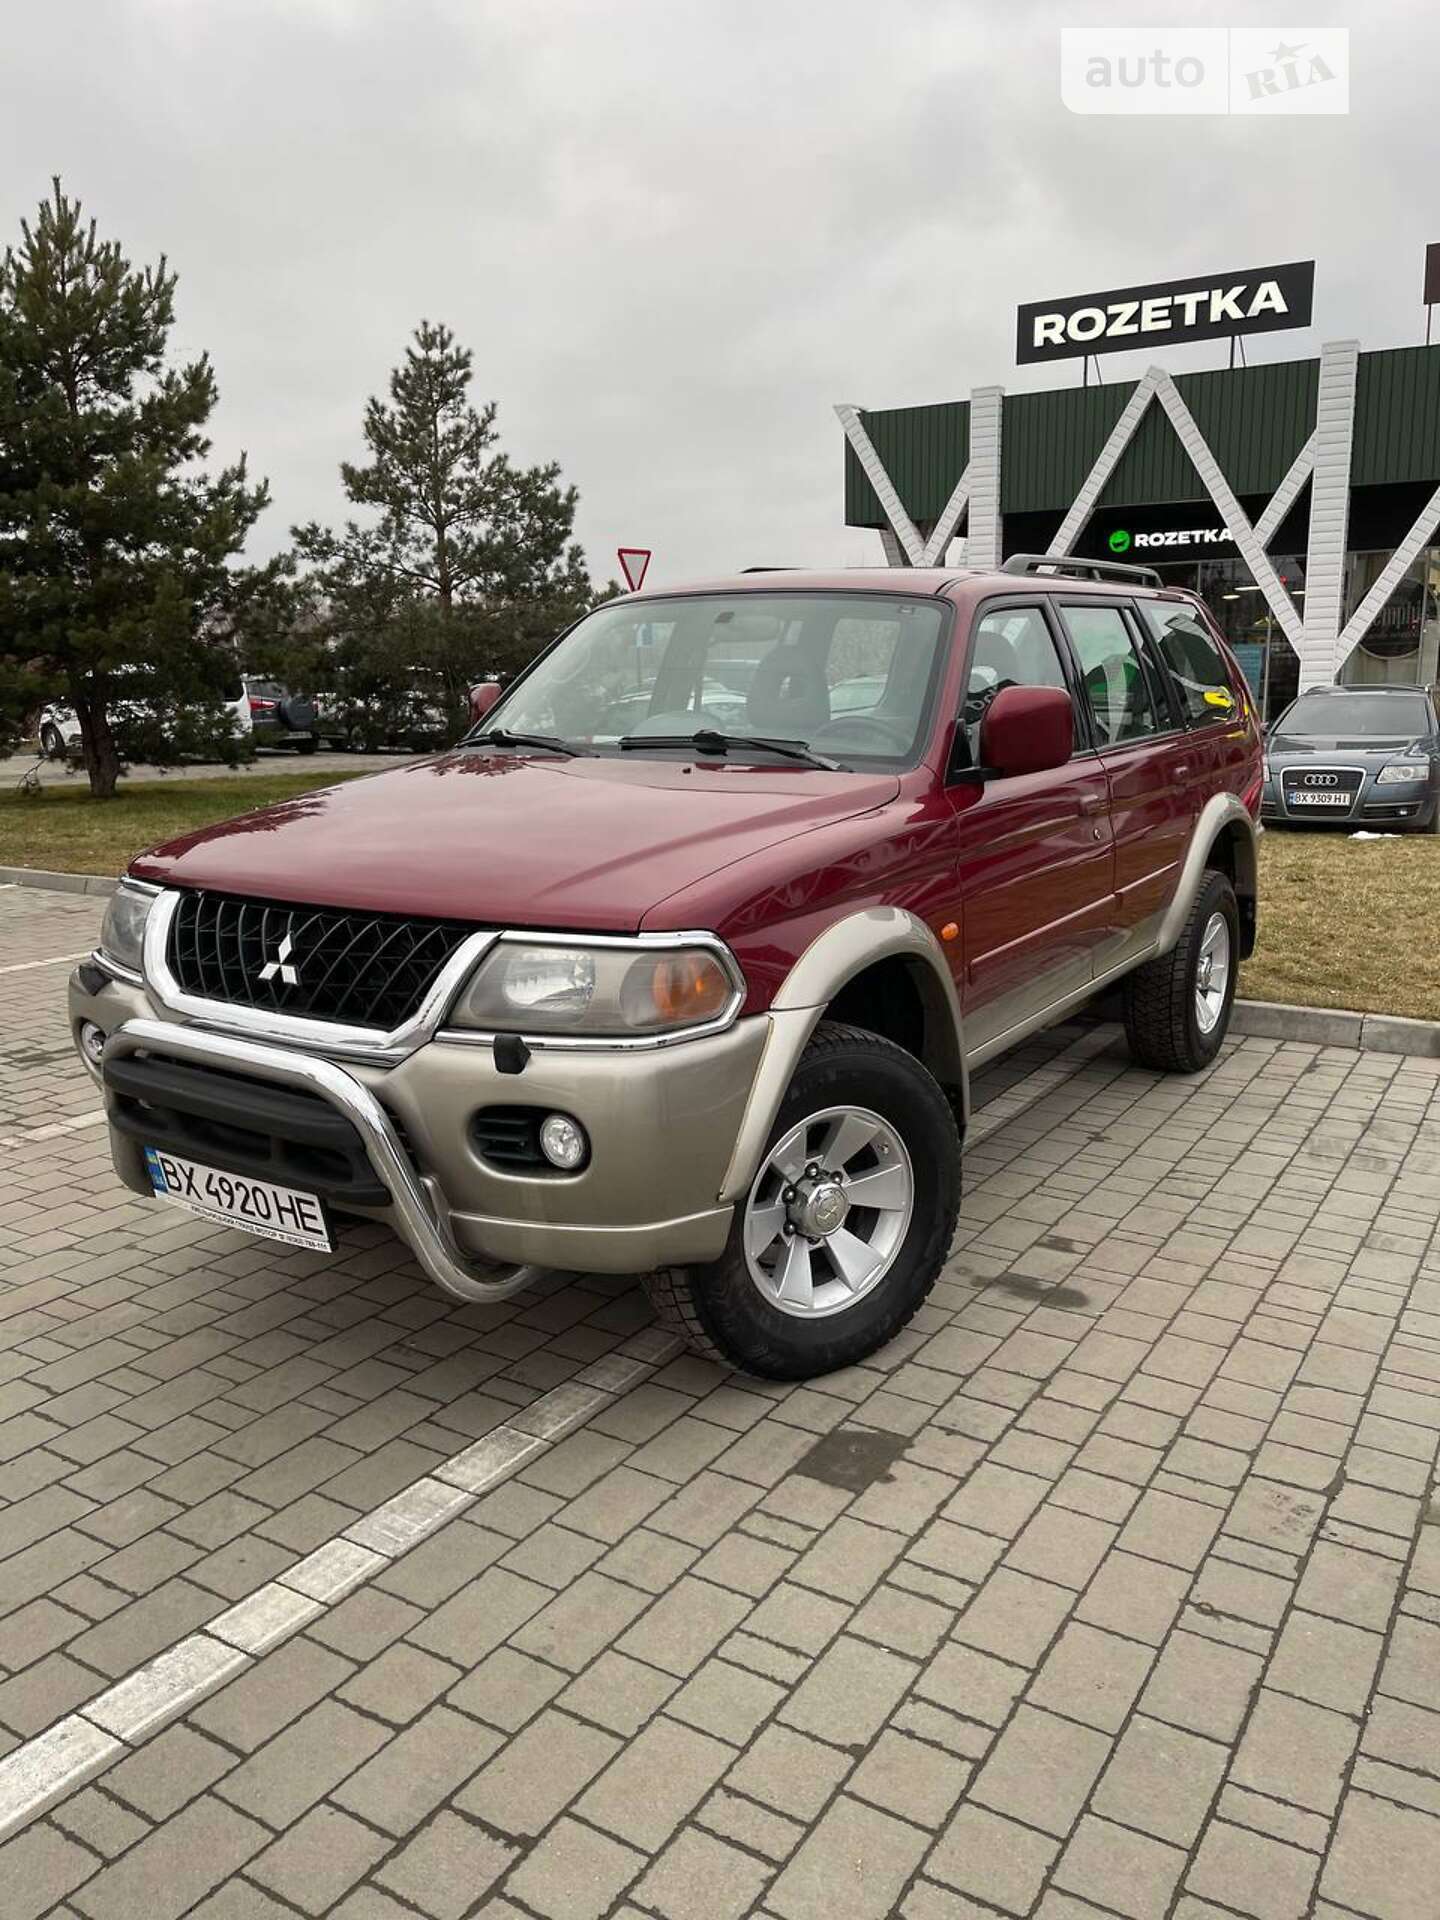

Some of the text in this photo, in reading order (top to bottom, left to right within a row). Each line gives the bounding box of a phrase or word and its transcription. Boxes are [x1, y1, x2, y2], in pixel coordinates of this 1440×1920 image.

[1033, 281, 1288, 347] ROZETKA
[1134, 528, 1234, 547] ROZETKA
[160, 1157, 203, 1200] BX
[205, 1173, 271, 1220] 4920
[273, 1191, 324, 1235] HE
